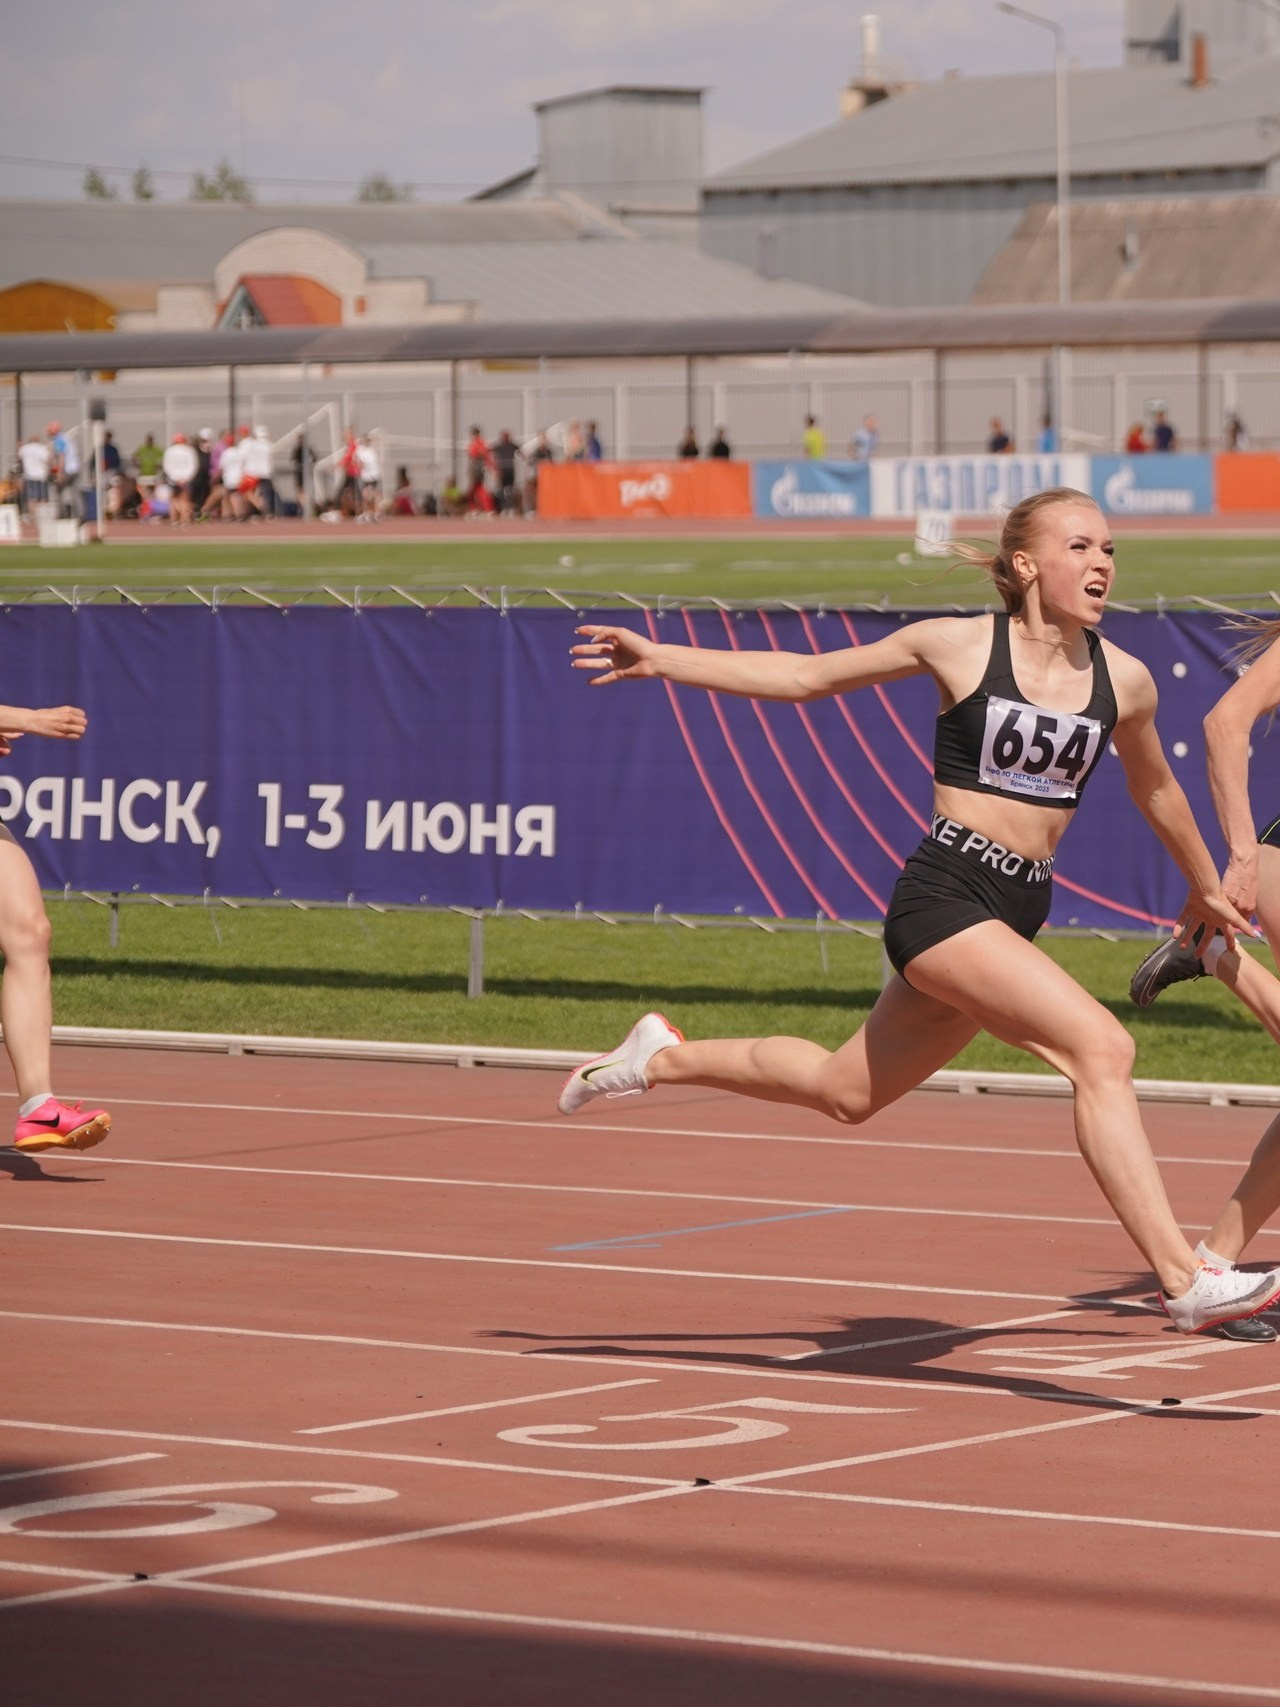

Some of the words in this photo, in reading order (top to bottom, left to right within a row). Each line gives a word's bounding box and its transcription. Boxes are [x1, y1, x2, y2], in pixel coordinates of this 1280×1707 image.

[896, 462, 1062, 511] ГАЗПРОМ
[992, 708, 1090, 782] 654
[0, 774, 222, 859] РЯНСК,
[256, 781, 346, 851] 1-3
[363, 799, 557, 858] июня
[929, 812, 964, 847] KE
[960, 831, 1025, 876] PRO
[1026, 853, 1056, 883] NIK
[496, 1396, 920, 1452] 5
[0, 1479, 400, 1540] 6
